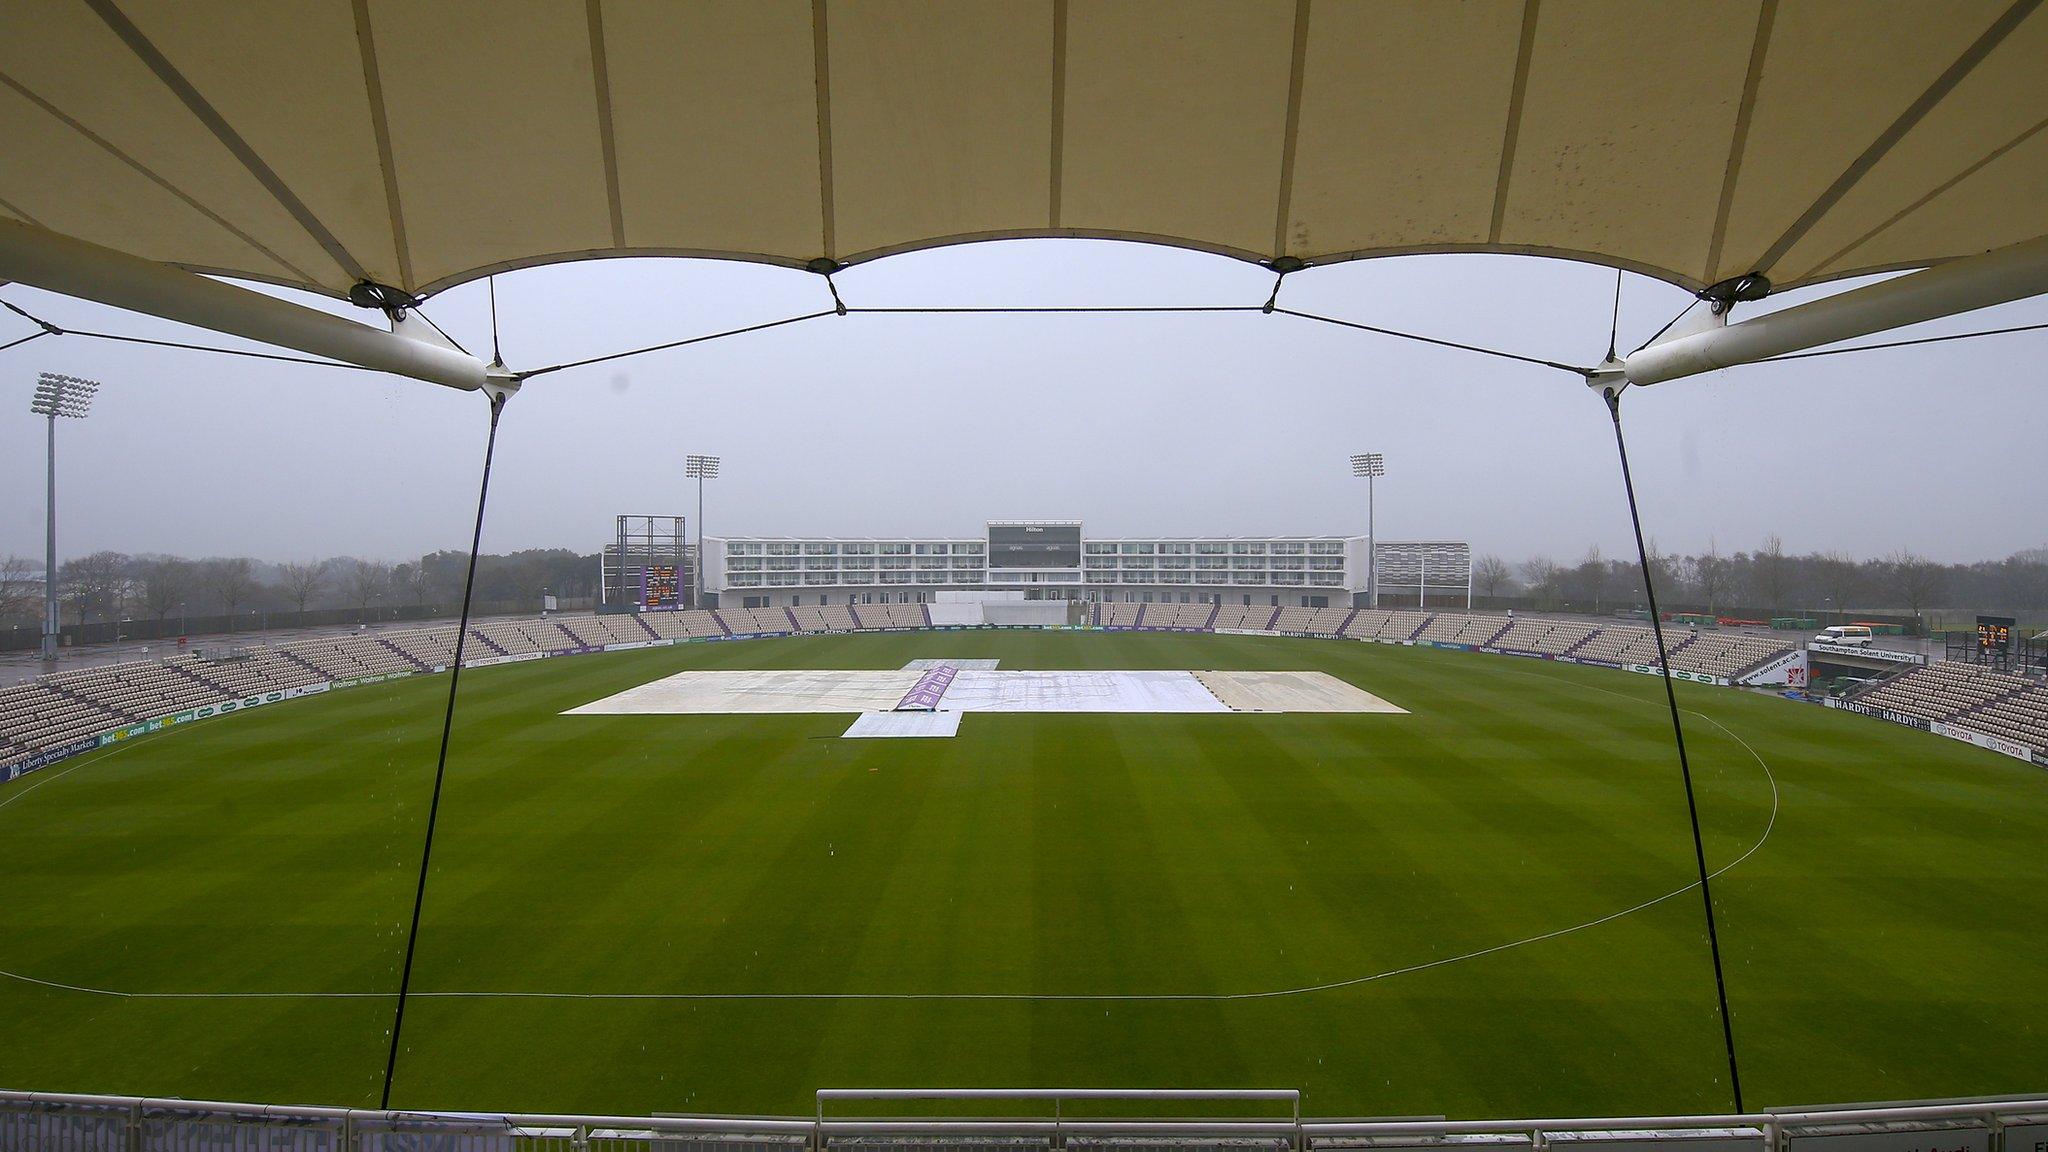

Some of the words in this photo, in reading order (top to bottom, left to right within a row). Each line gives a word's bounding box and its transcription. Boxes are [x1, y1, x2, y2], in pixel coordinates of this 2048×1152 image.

[517, 653, 537, 661] TOYOTA
[1479, 646, 1501, 655] NatWest
[1554, 655, 1577, 664] NatWest
[1818, 644, 1859, 656] Southampton
[1860, 650, 1879, 658] Solent
[1880, 651, 1912, 663] University
[1740, 652, 1800, 685] www.solent.ac.uk
[332, 680, 358, 689] Waitrose
[359, 675, 385, 684] Waitrose
[386, 670, 412, 679] Waitrose
[1835, 700, 1870, 716] HARDYS
[149, 713, 192, 731] bet365.com
[1882, 710, 1918, 728] HARDYS
[102, 726, 145, 744] bet365.com
[1947, 728, 1973, 741] TOYOTA
[22, 755, 43, 770] Liberty
[43, 747, 70, 765] Specialty
[69, 740, 95, 754] Markets
[1997, 741, 2024, 757] TOYOTA
